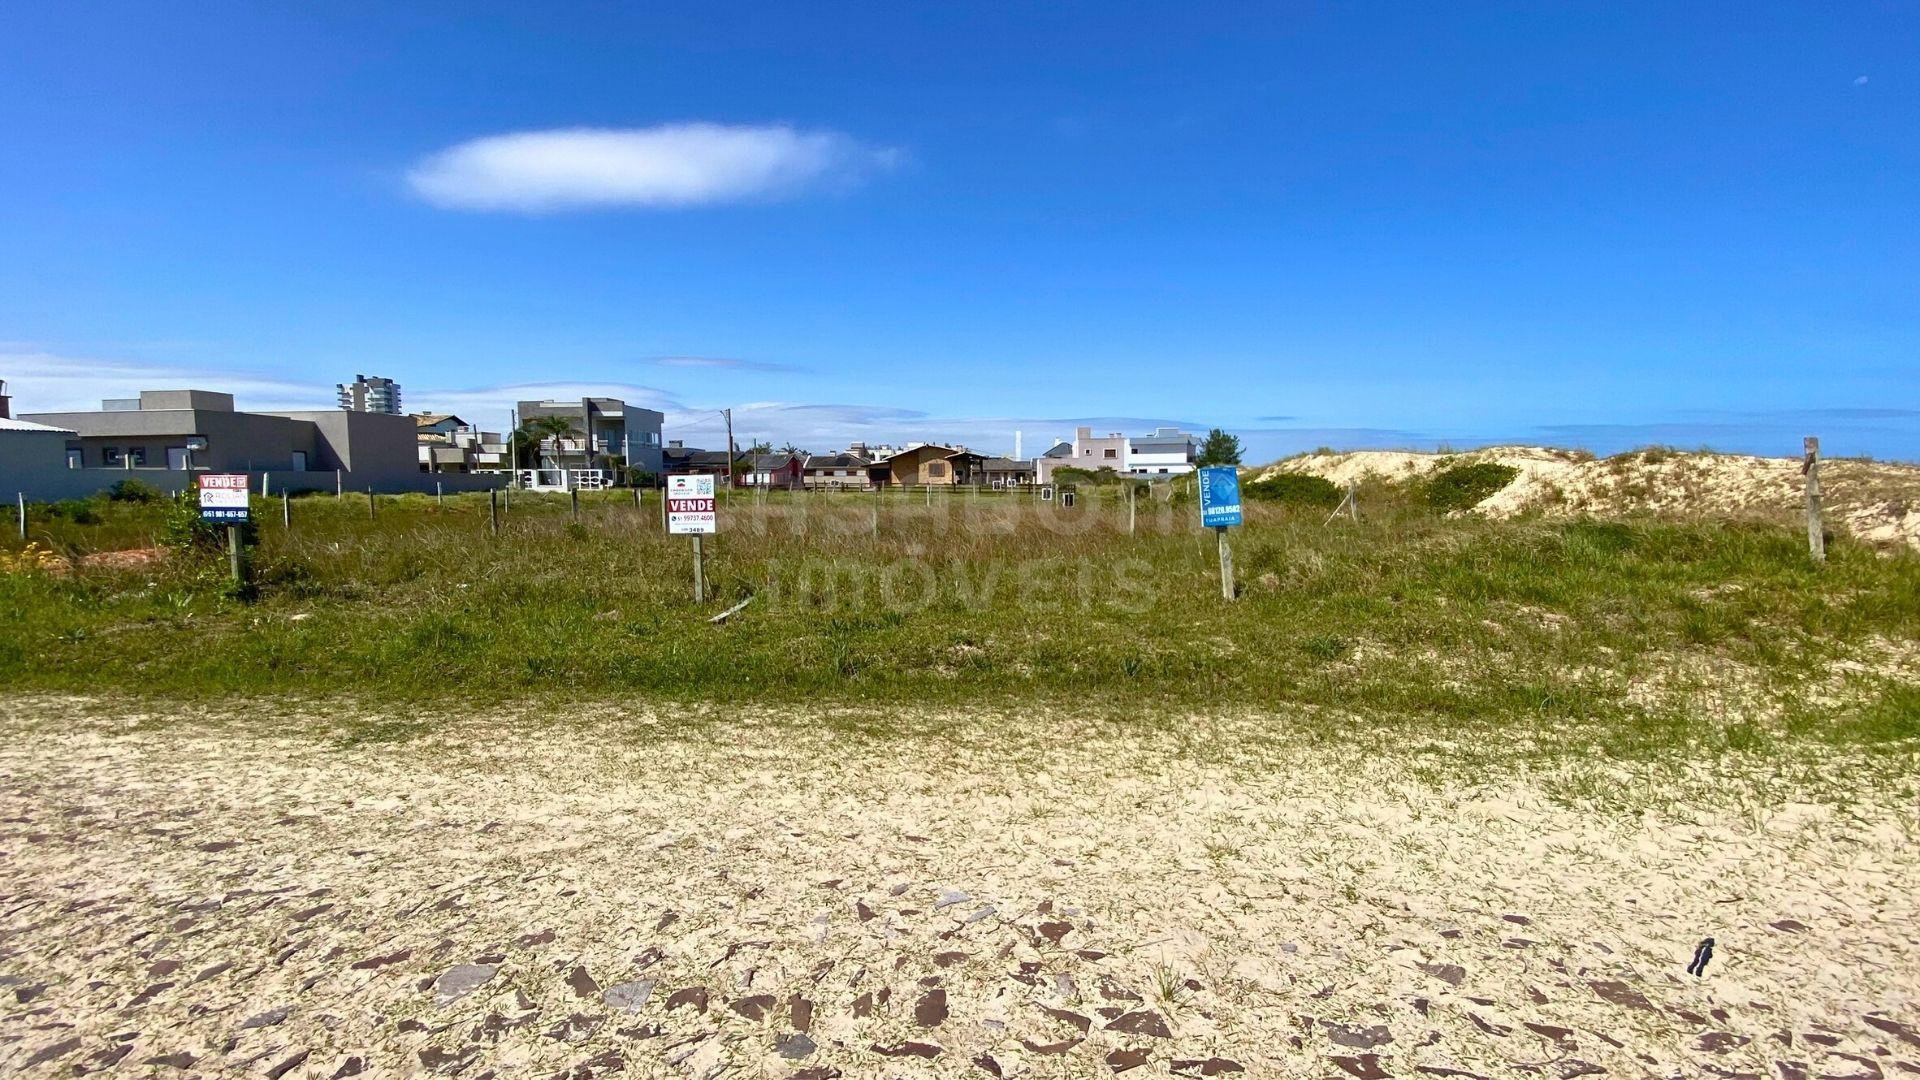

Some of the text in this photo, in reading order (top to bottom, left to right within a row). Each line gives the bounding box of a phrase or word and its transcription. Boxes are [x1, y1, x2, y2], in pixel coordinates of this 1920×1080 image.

[202, 477, 236, 488] VENDE
[1201, 470, 1211, 506] VENDE
[670, 500, 714, 512] VENDE
